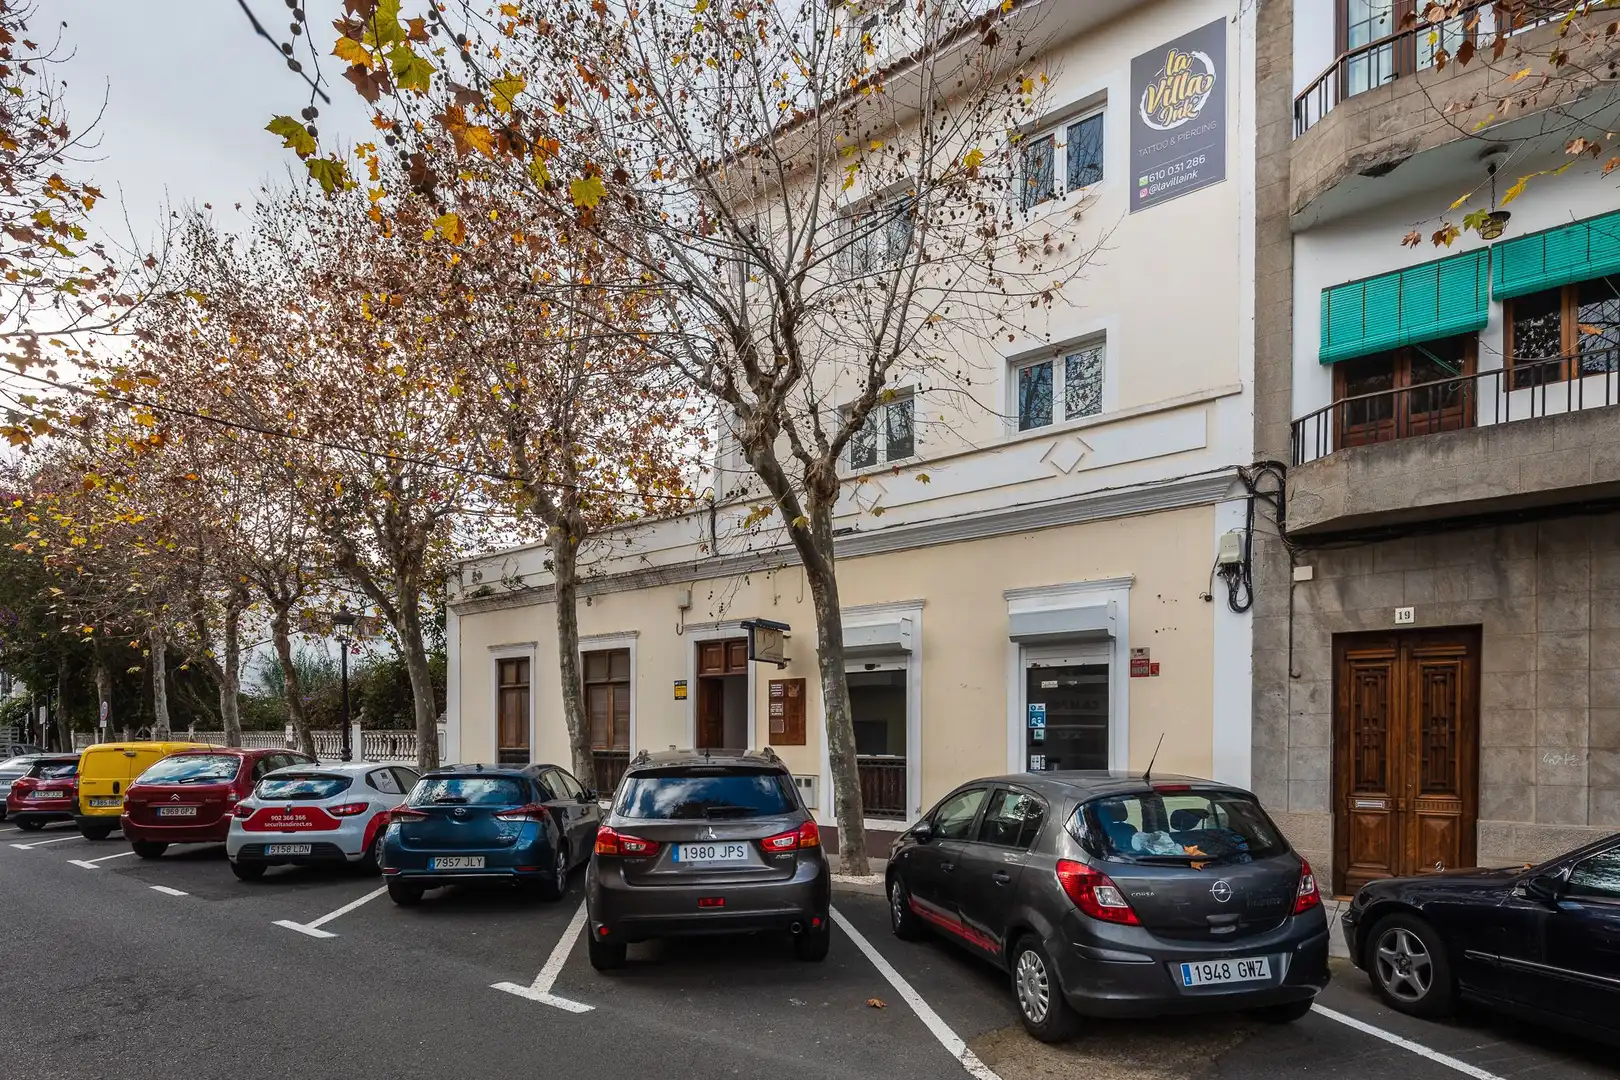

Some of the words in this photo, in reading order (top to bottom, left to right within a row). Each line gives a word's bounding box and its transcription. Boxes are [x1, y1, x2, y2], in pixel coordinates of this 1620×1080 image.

[1146, 71, 1215, 115] Villa
[1138, 140, 1169, 157] TATTOO
[1177, 120, 1217, 142] PIERCING
[1148, 169, 1166, 183] 610
[1167, 162, 1184, 176] 031
[1186, 154, 1206, 170] 286
[1148, 169, 1199, 195] @lavillaink
[1398, 610, 1411, 620] 19
[270, 844, 292, 853] 5158
[683, 846, 715, 860] 1980
[719, 845, 744, 858] JPS
[435, 857, 461, 868] 7957
[464, 857, 484, 868] JLY
[1195, 962, 1231, 982] 1948
[1237, 959, 1267, 979] GWZ
